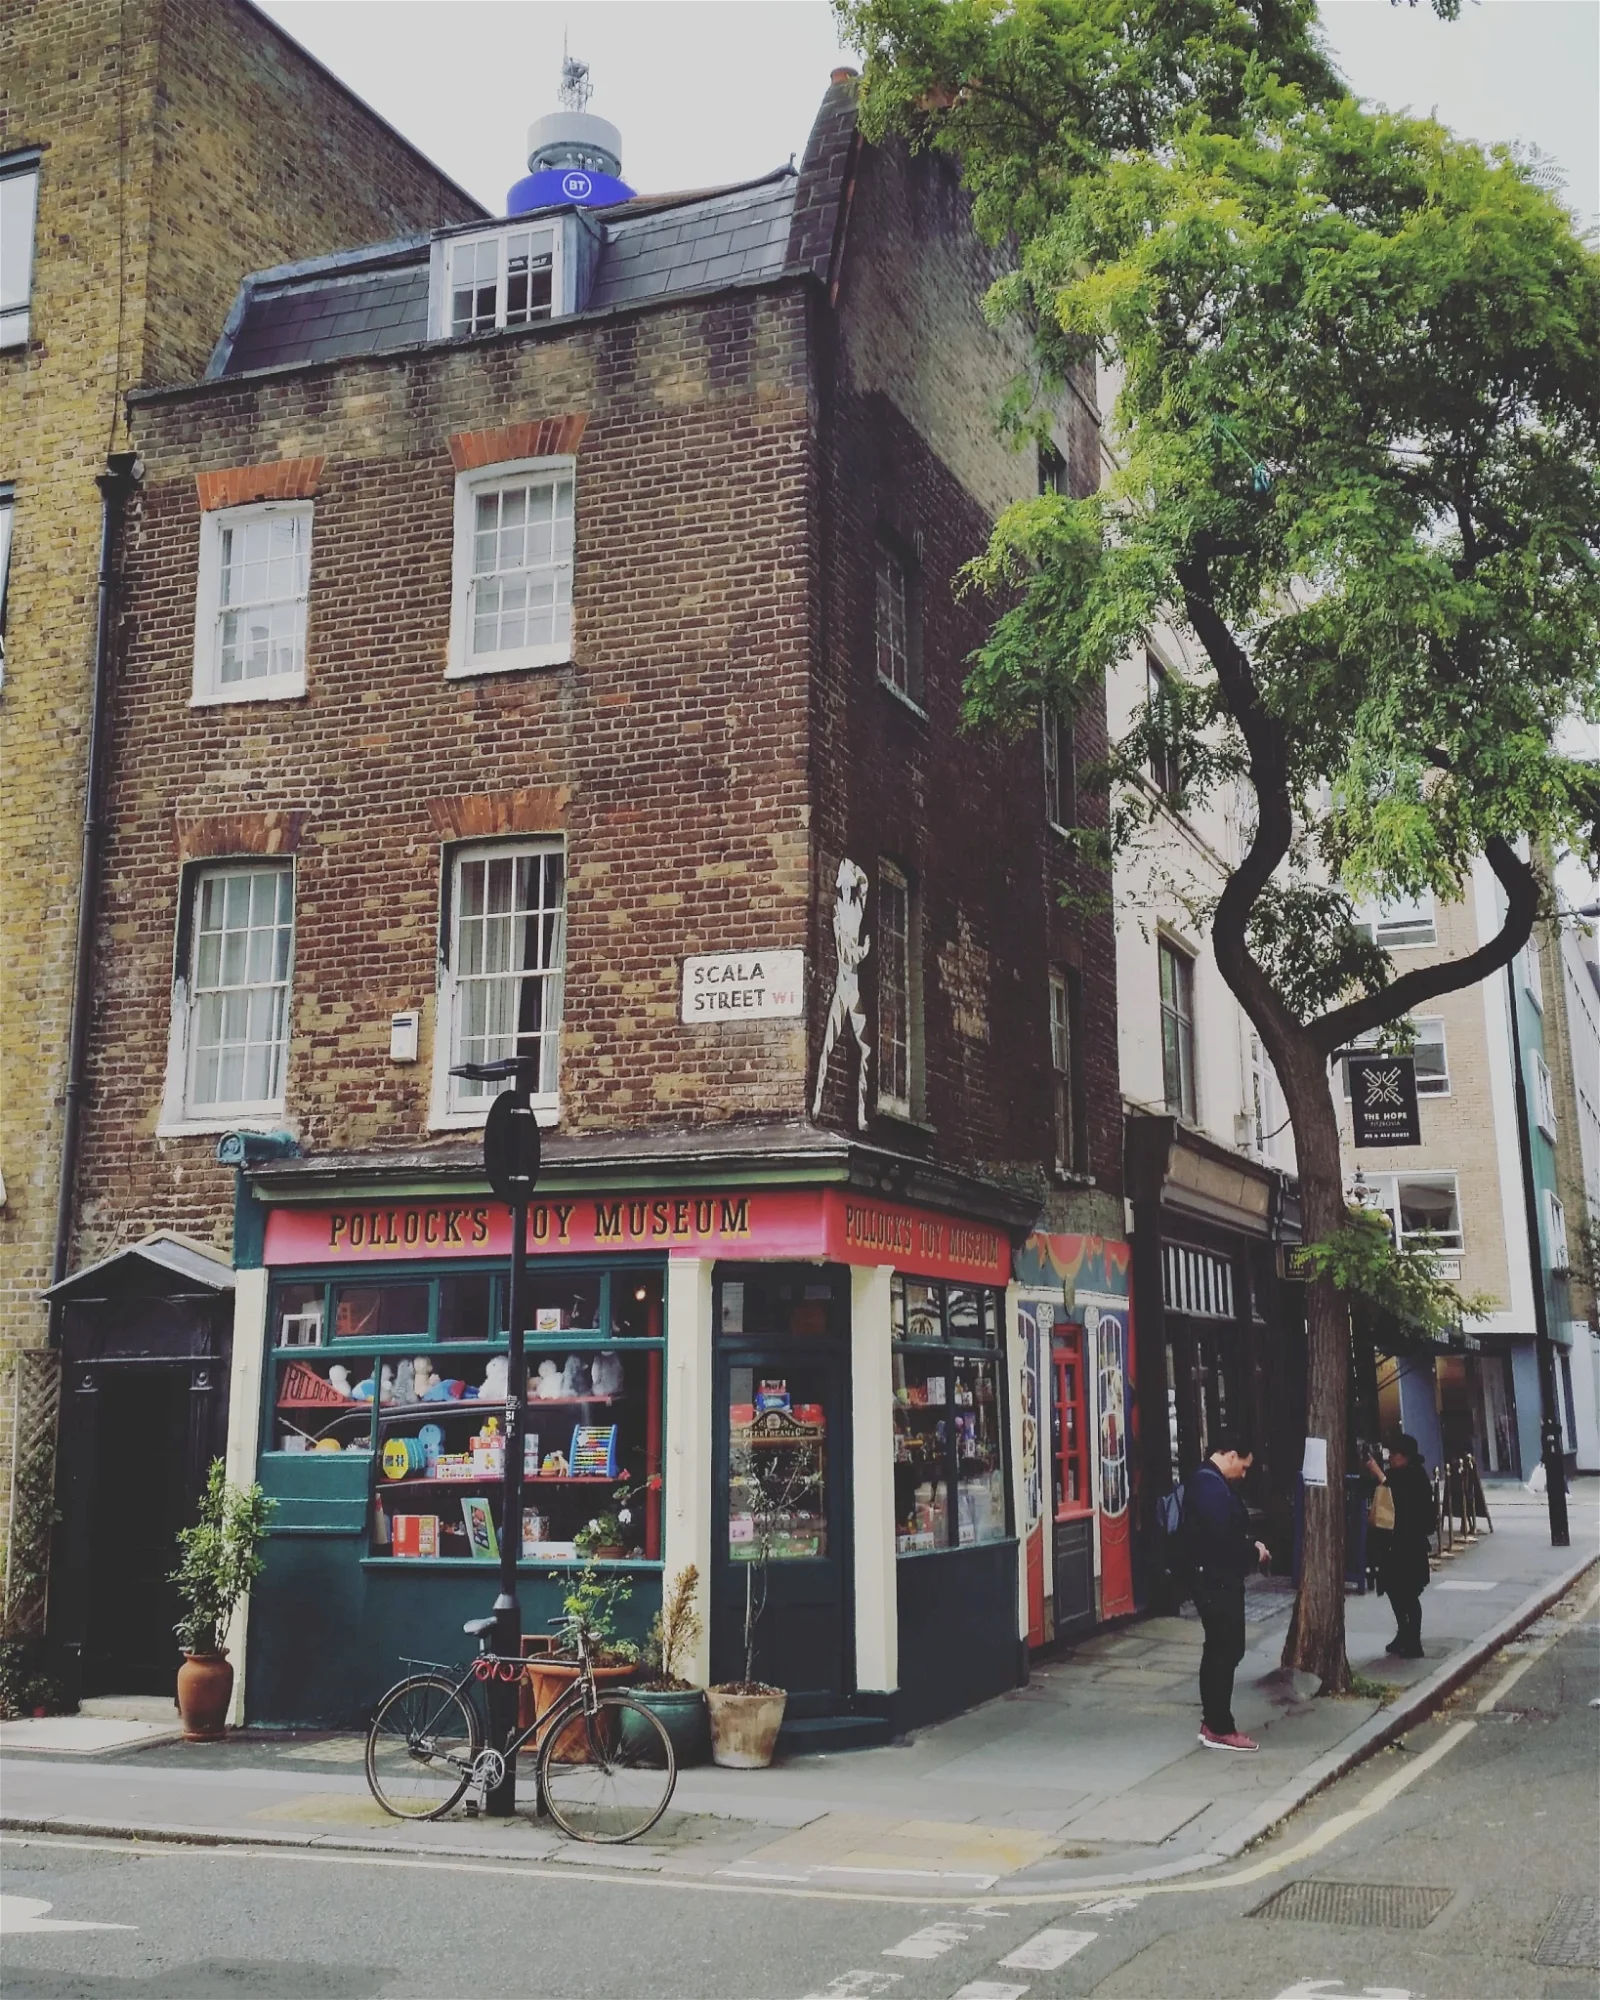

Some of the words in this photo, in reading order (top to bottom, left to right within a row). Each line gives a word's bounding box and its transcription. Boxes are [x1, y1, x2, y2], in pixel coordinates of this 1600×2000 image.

[569, 180, 585, 190] BT
[694, 962, 765, 985] SCALA
[694, 988, 766, 1011] STREET
[772, 991, 795, 1004] W1
[1384, 1112, 1407, 1120] HOPE
[328, 1208, 490, 1253] POLLOCK'S
[509, 1203, 576, 1246] OY
[593, 1198, 751, 1242] MUSEUM
[846, 1204, 912, 1255] POLLOCK'S
[919, 1221, 944, 1260] TOY
[948, 1229, 998, 1268] MUSEUM
[505, 1410, 515, 1421] 51
